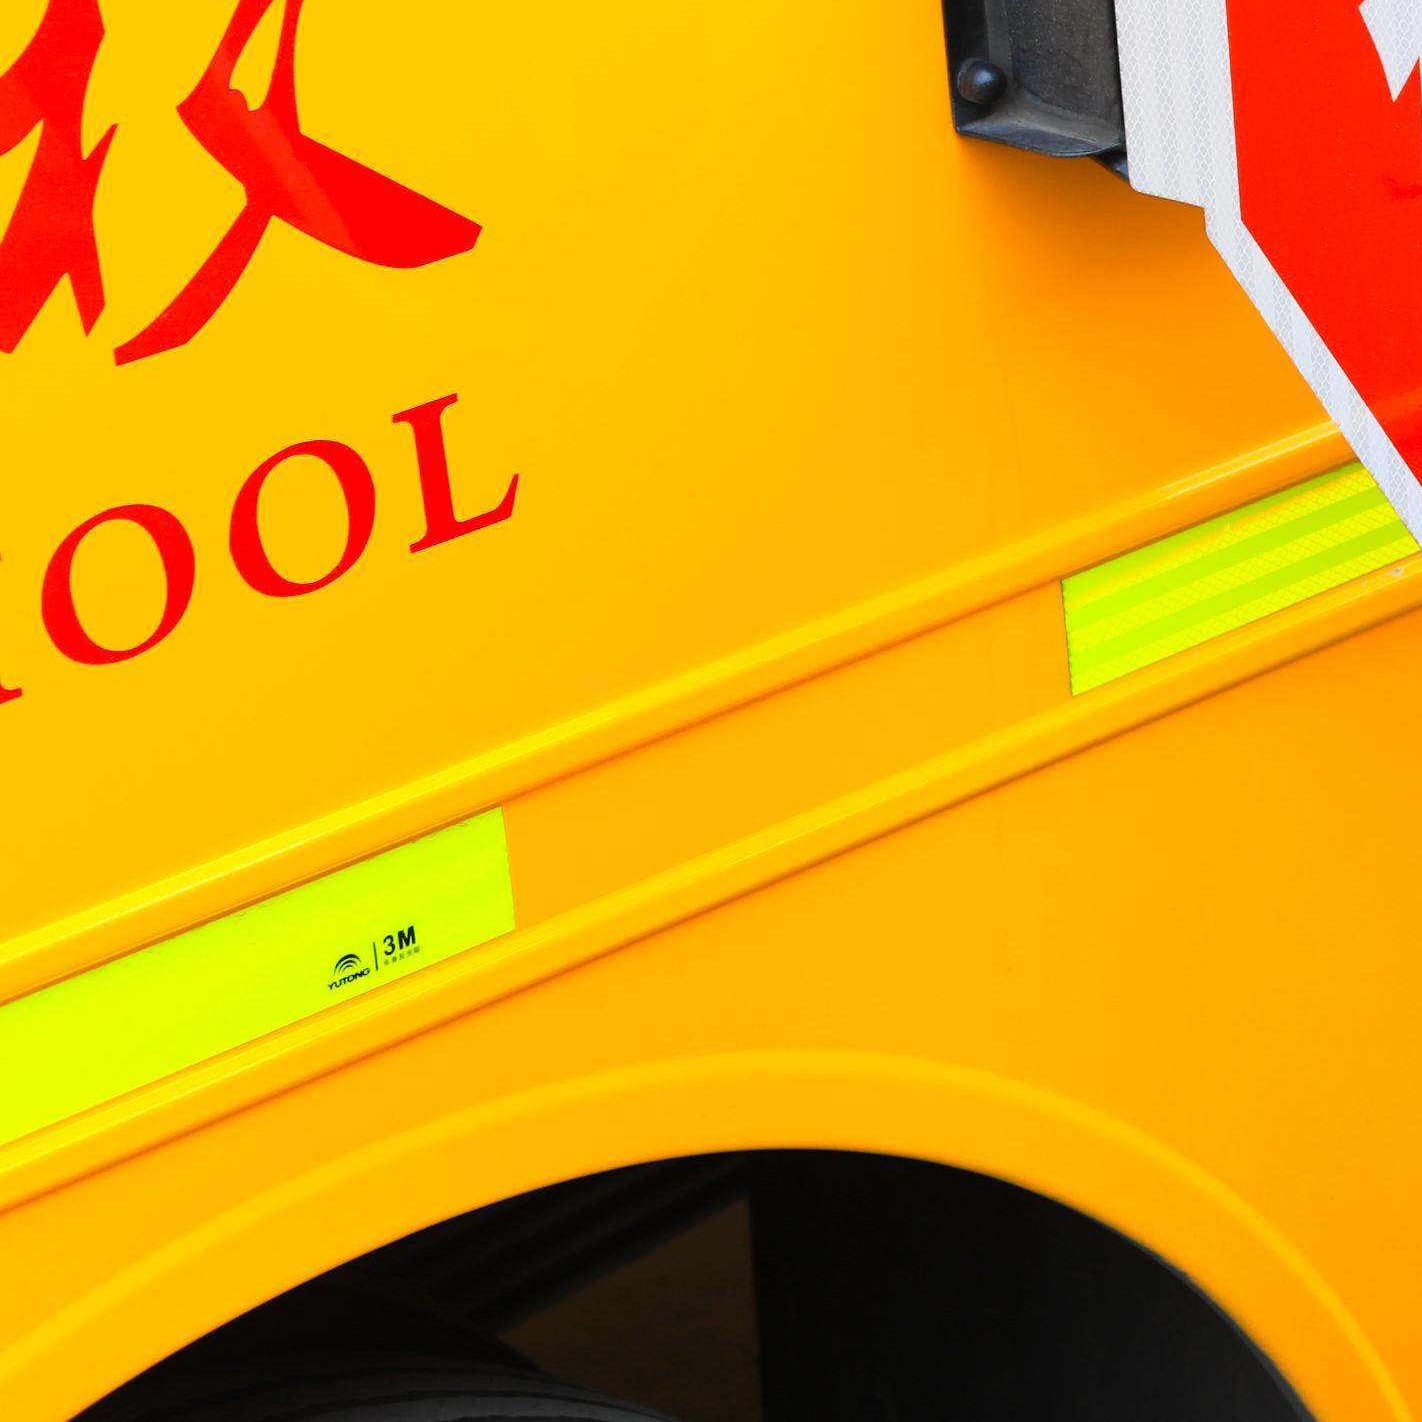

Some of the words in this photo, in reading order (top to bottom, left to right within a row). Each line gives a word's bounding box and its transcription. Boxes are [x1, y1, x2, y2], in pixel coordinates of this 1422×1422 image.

[0, 392, 520, 705] OOL
[383, 925, 416, 956] 3M
[328, 967, 370, 990] YUTONG
